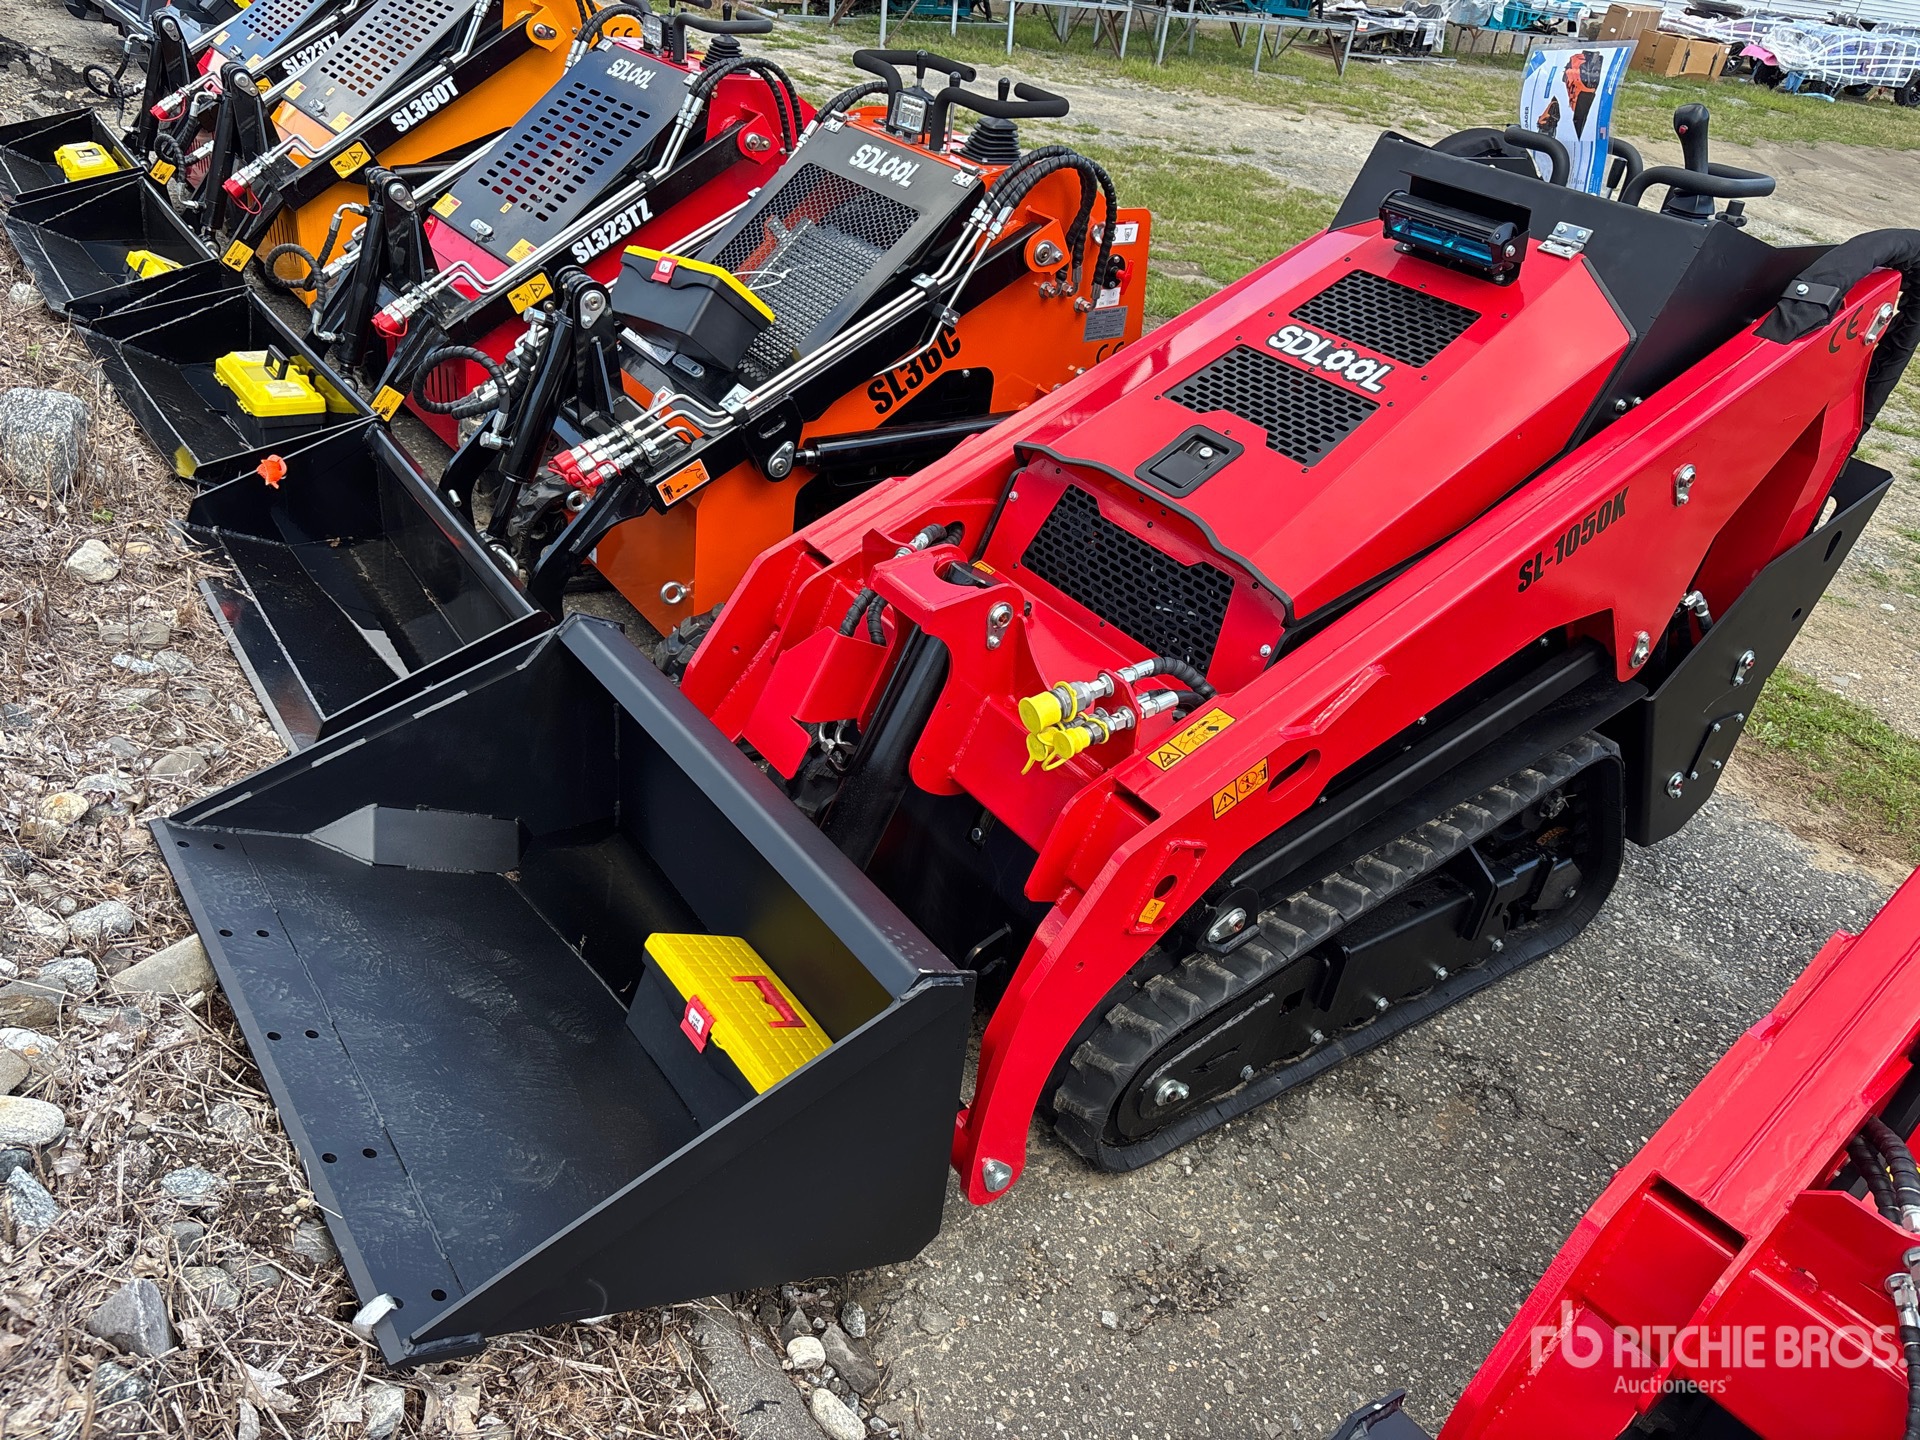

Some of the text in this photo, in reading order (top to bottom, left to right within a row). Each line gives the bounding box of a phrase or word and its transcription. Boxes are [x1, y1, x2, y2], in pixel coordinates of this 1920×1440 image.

[390, 75, 459, 133] SL360T
[606, 58, 657, 90] SDLOOL
[848, 143, 921, 188] SDLOOL
[571, 197, 654, 264] SL323TZ
[867, 327, 961, 415] SL36C
[1267, 324, 1393, 393] SDLOOL
[1517, 485, 1630, 593] SL-1050K
